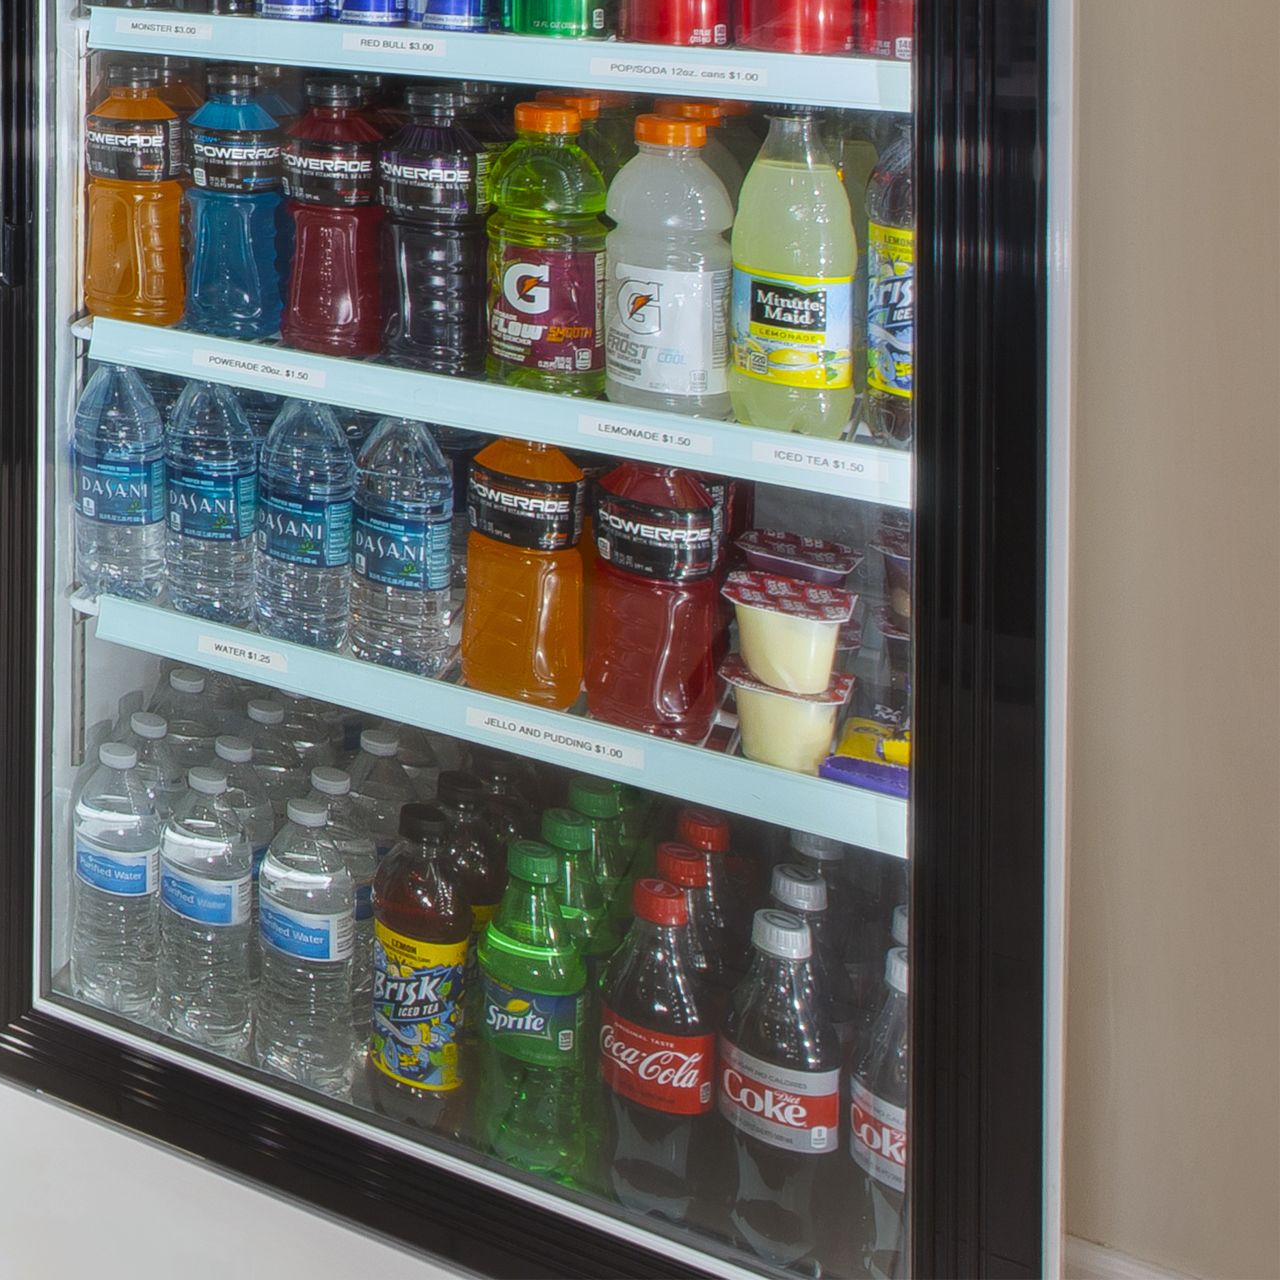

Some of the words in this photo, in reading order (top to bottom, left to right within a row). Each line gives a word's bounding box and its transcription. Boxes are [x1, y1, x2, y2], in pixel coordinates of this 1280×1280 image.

[131, 22, 172, 33] MONSTER
[360, 38, 380, 48] RED
[382, 40, 406, 50] BULL
[409, 42, 434, 52] $3.00
[610, 63, 667, 75] POP/SODA
[671, 67, 699, 77] 12oz.
[728, 71, 759, 82] $1.00
[503, 263, 550, 314] G
[755, 288, 821, 311] Minute
[764, 306, 814, 324] Maid
[607, 332, 649, 359] FROST
[758, 327, 817, 342] LEMONADE
[208, 355, 259, 371] POWERADE
[261, 364, 283, 376] 20oz.
[284, 369, 308, 381] $1.50
[657, 351, 687, 365] COOL
[597, 423, 659, 441] LEMONADE
[662, 434, 691, 447] $1.50
[773, 449, 803, 463] ICED
[806, 455, 830, 468] TEA
[832, 459, 864, 473] $1.50
[82, 474, 148, 499] DASANI
[169, 488, 235, 515] DASANI
[213, 642, 246, 658] WATER
[247, 649, 270, 664] $1.25
[484, 716, 517, 732] JELLO
[519, 725, 541, 740] AND
[544, 733, 592, 753] PUDDING
[595, 745, 623, 760] $1.00
[292, 930, 324, 944] Water
[391, 937, 417, 953] LEMON
[373, 972, 440, 1002] Brisk
[397, 1004, 419, 1018] ICED
[421, 1002, 440, 1016] TEA
[599, 1023, 703, 1089] Coca-Cola
